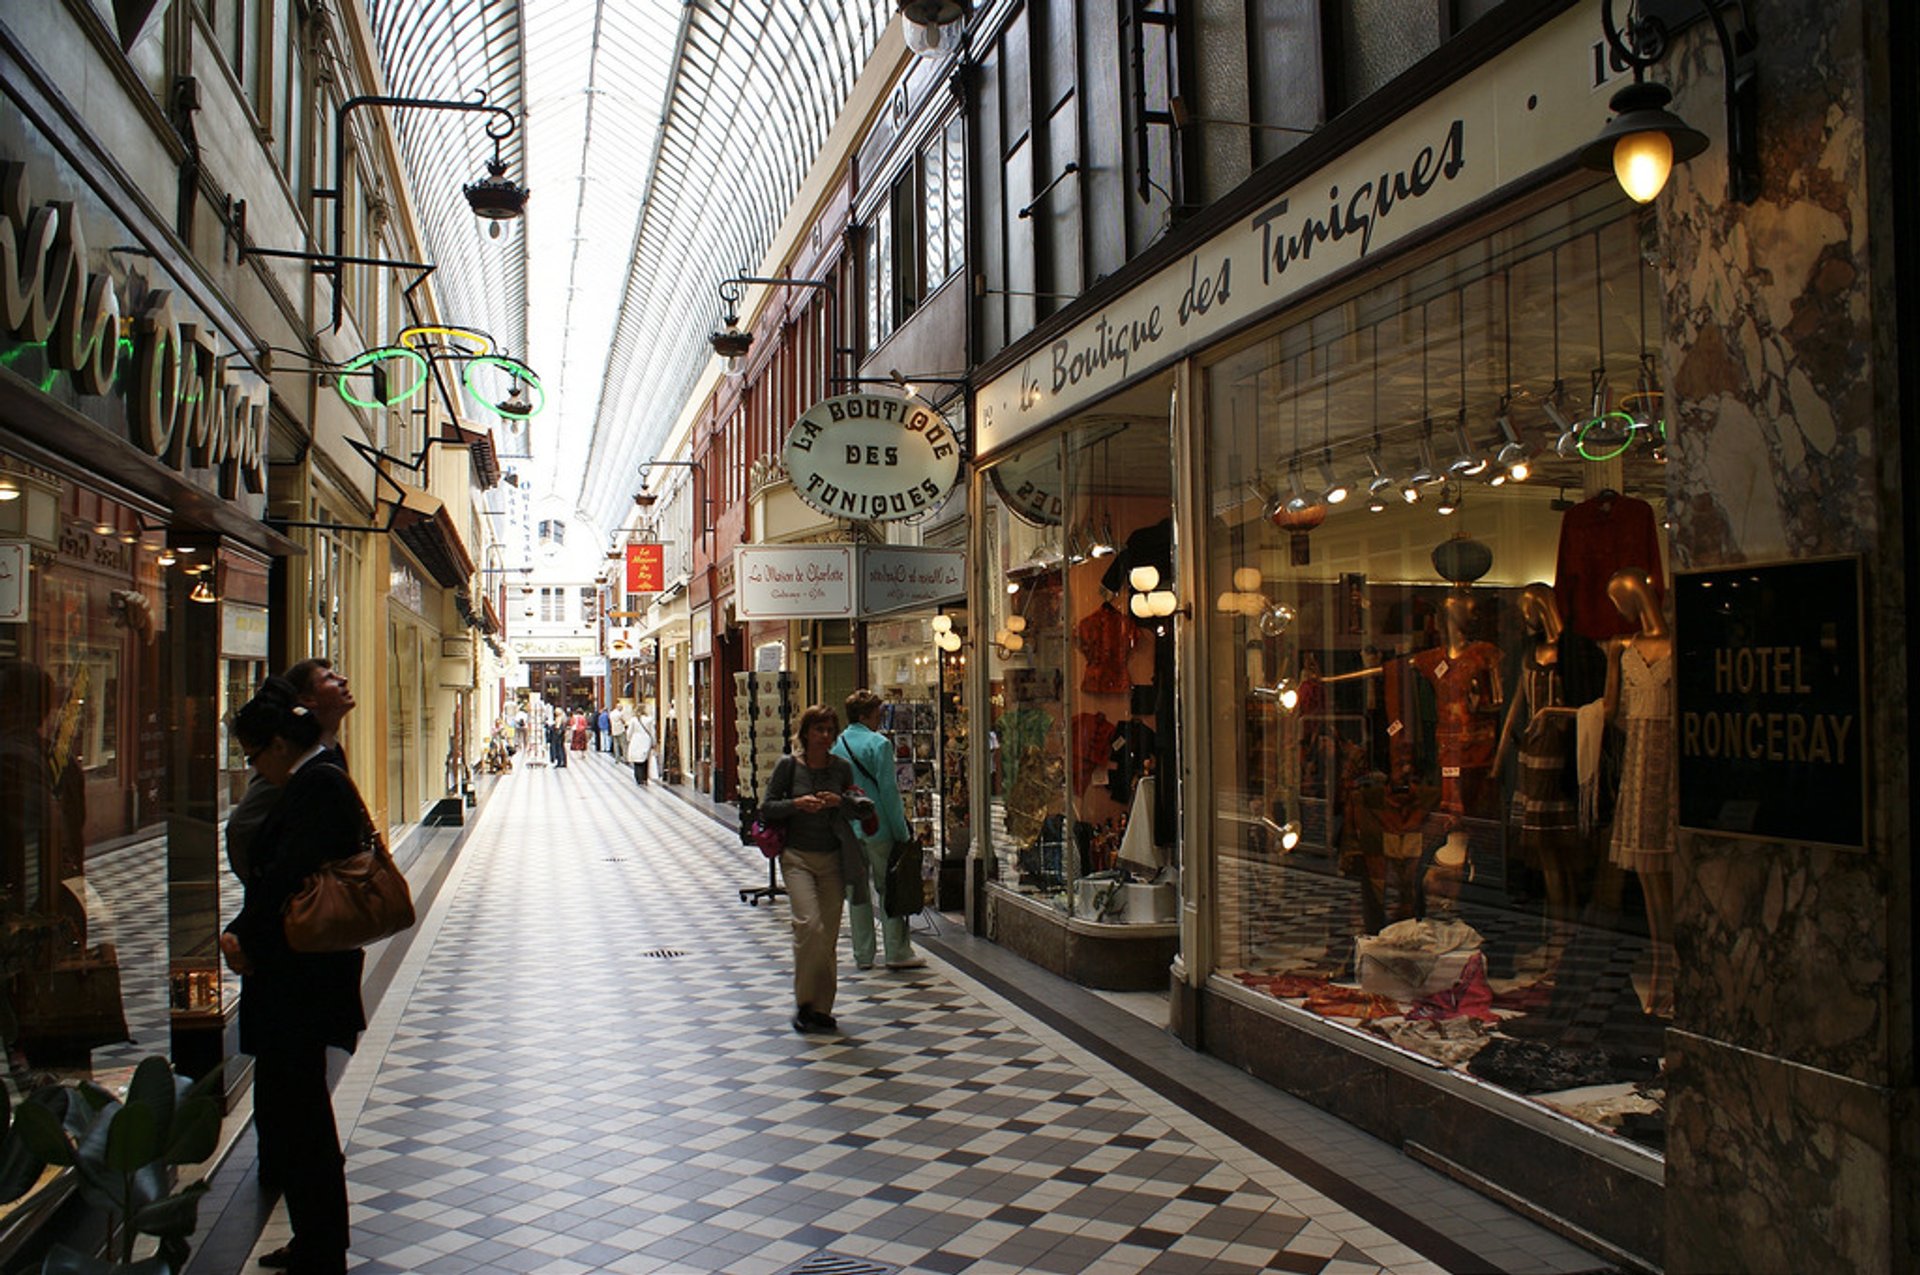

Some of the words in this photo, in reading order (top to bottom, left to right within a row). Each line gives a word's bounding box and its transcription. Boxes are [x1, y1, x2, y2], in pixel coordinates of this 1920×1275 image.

[1051, 313, 1165, 396] Boutique
[1178, 254, 1232, 327] des
[1251, 119, 1465, 287] Tuniques
[792, 420, 824, 453] LA
[828, 399, 954, 461] BOUTIQUE
[845, 444, 899, 467] DES
[806, 472, 940, 519] TUNIQUES
[1715, 647, 1812, 694] HOTEL
[1683, 712, 1853, 765] RONCERAY
